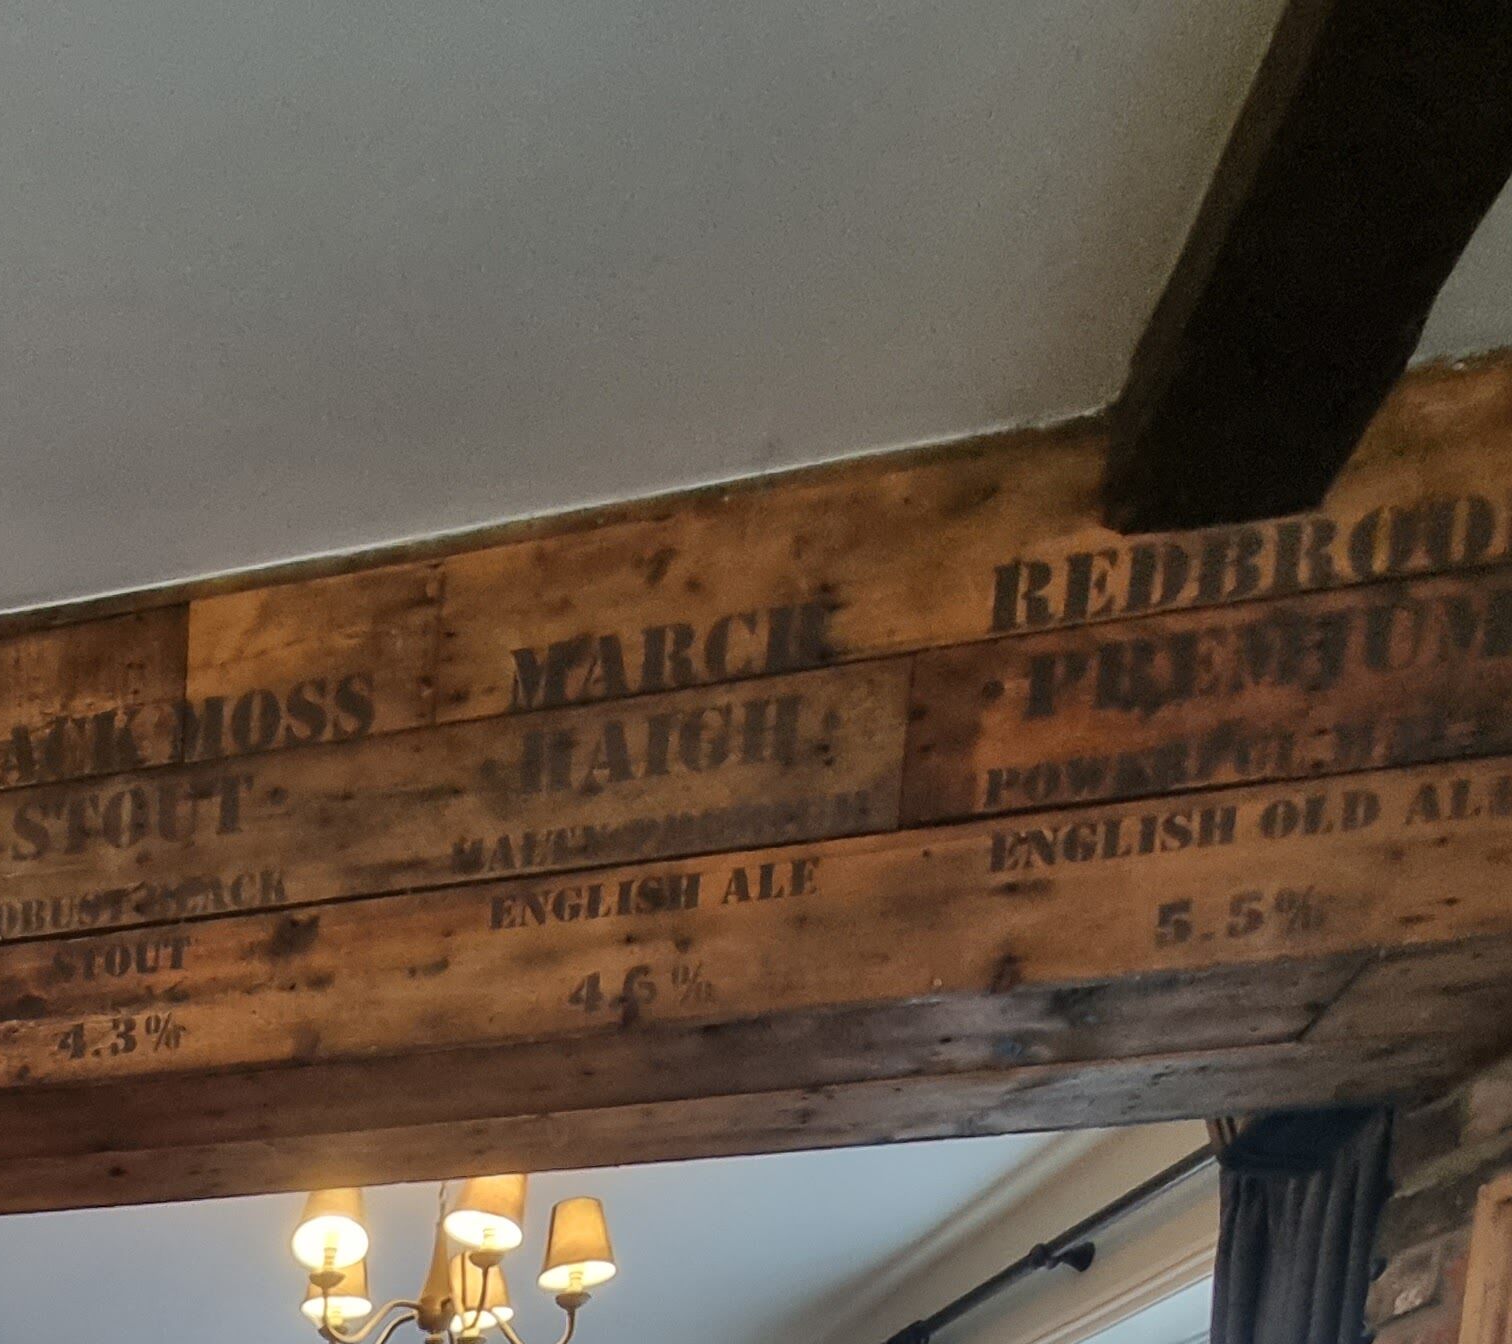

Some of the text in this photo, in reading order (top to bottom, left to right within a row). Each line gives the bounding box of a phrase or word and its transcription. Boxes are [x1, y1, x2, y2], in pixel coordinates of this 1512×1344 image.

[992, 494, 1512, 634] REDBROO
[509, 600, 835, 711] MARCH
[180, 674, 374, 758] MOSS
[518, 693, 803, 795] HAIGH
[10, 776, 256, 862] STOUT
[988, 808, 1238, 873] ENGLISH
[1260, 787, 1382, 840] OLD
[488, 856, 822, 931] ENGLISH ALE
[1154, 884, 1326, 948] 5.5%
[51, 934, 192, 981] STOUT
[56, 1009, 190, 1061] 4.3%
